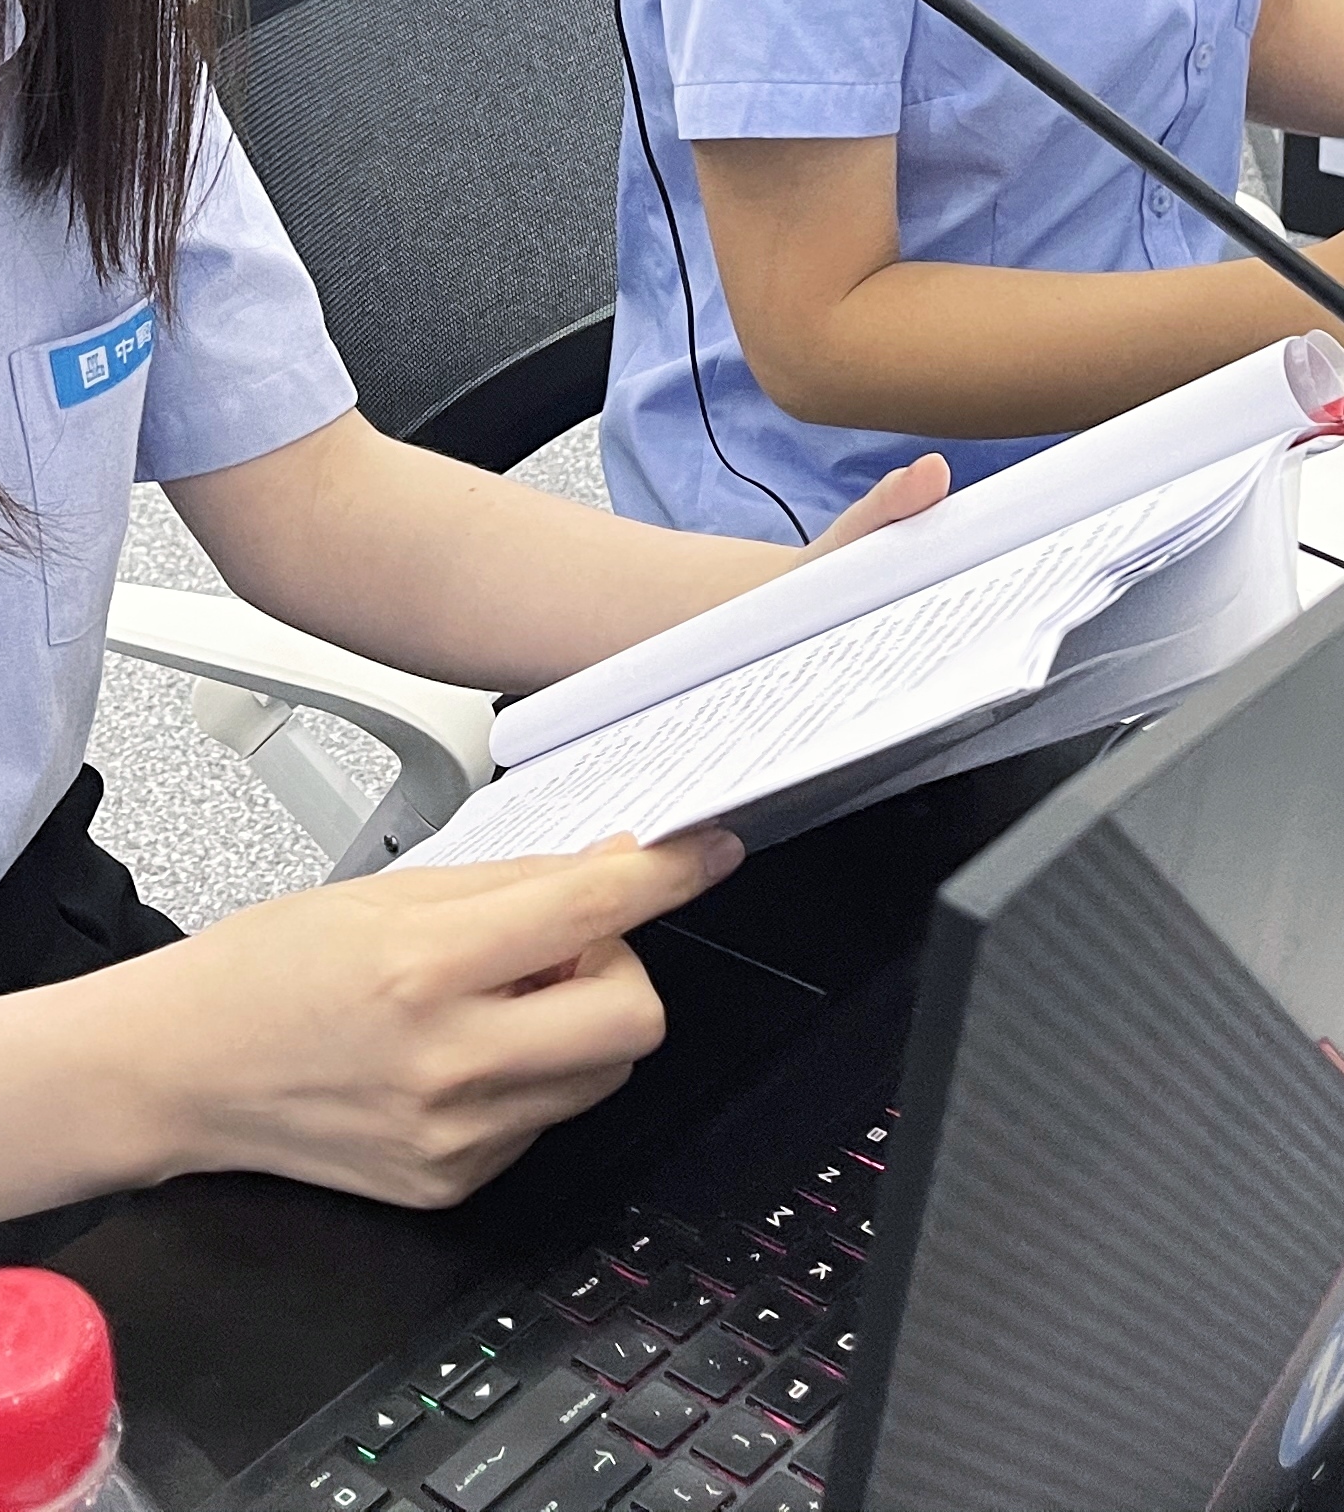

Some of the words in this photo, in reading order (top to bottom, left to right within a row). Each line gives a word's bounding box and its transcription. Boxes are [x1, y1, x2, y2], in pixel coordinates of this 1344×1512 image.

[817, 1166, 841, 1183] N
[765, 1205, 794, 1227] M
[808, 1261, 833, 1280] K
[788, 1379, 809, 1399] P
